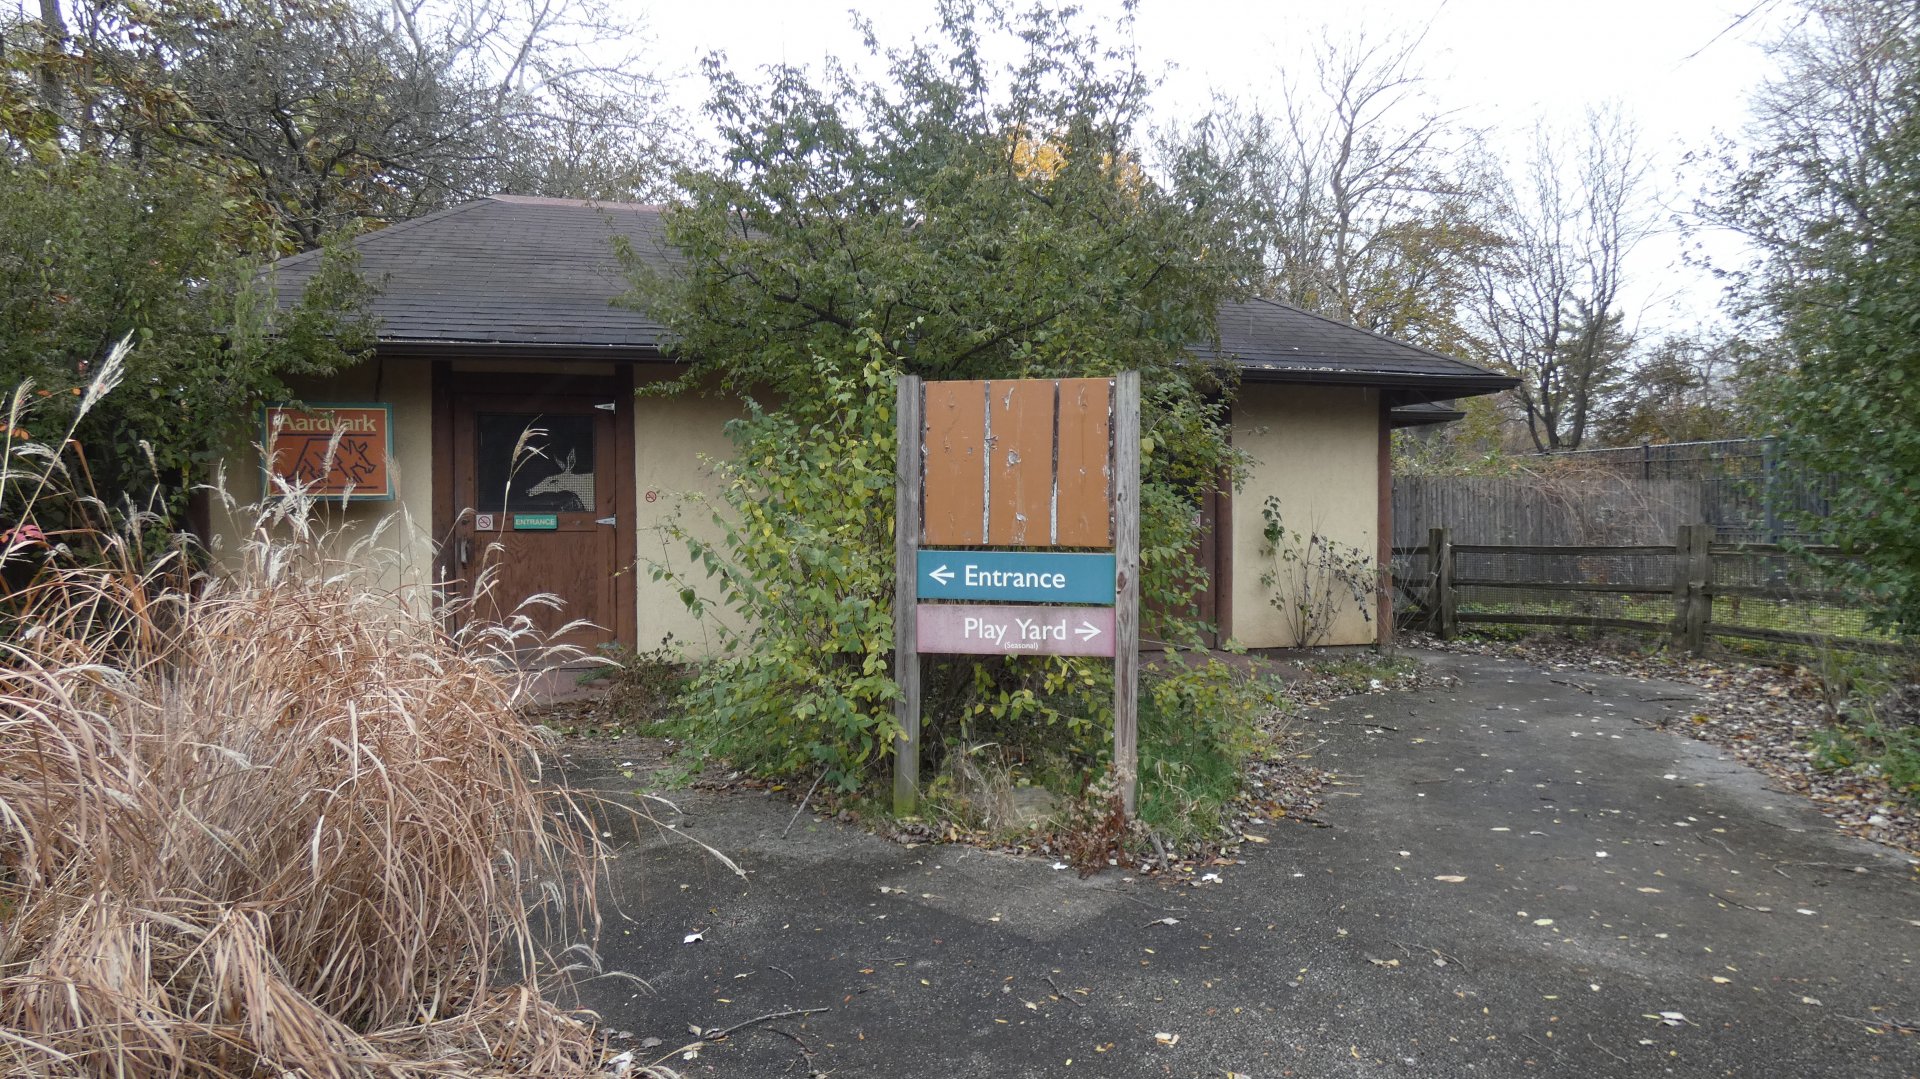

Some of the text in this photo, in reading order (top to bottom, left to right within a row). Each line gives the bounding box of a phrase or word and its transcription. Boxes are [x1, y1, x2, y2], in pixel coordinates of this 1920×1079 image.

[515, 518, 555, 526] ENTRANCE
[965, 564, 1065, 588] Entrance
[964, 617, 1066, 645] Play Yard
[1004, 641, 1039, 650] (Seasonal)
